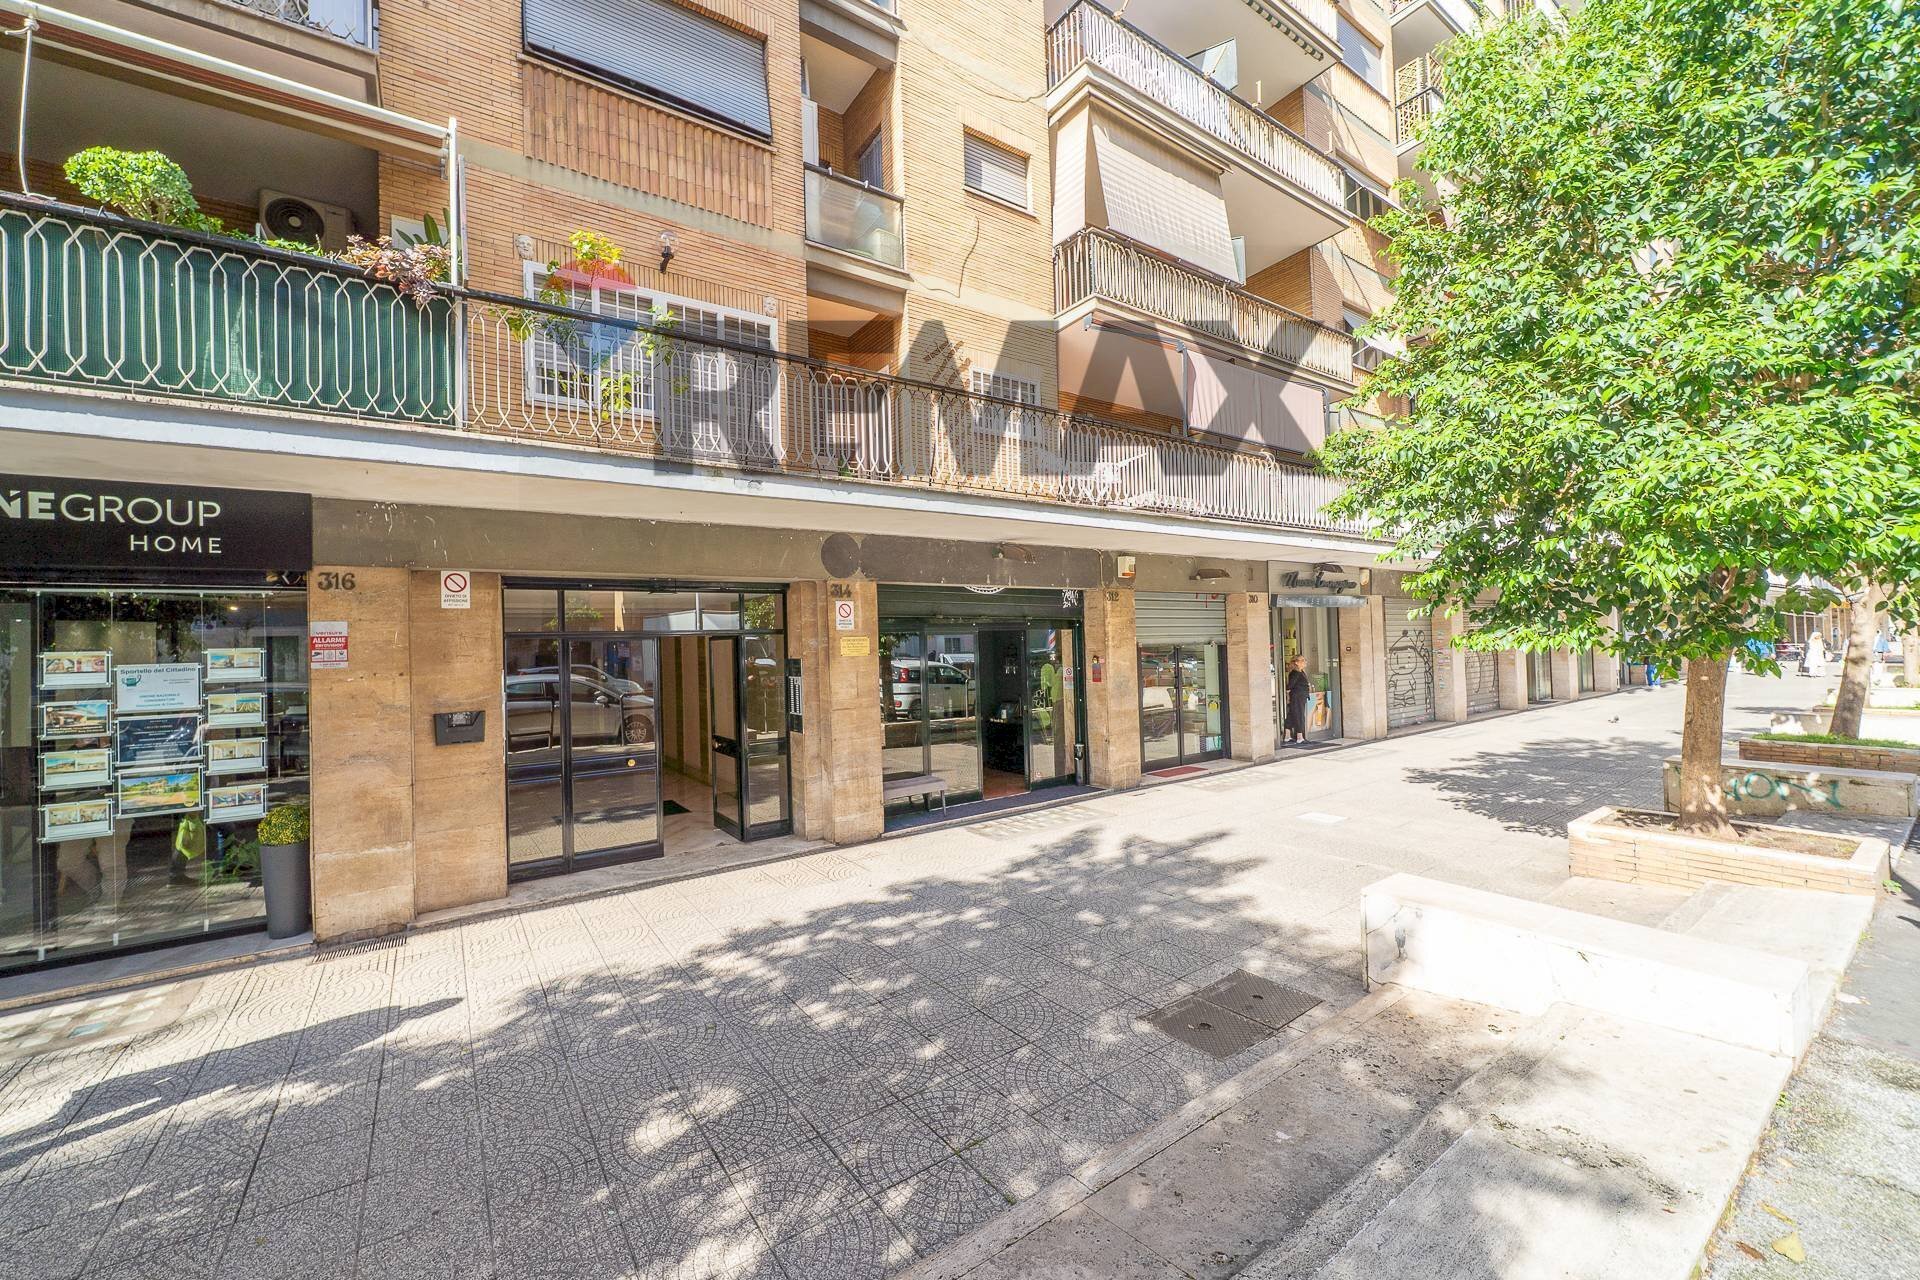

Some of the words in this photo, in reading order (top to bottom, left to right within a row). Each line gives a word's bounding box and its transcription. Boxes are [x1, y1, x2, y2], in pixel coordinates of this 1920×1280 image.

[130, 534, 222, 554] HOME
[318, 572, 356, 591] 316
[831, 584, 852, 598] 314
[1106, 591, 1120, 602] 312
[312, 637, 346, 645] ALLARME
